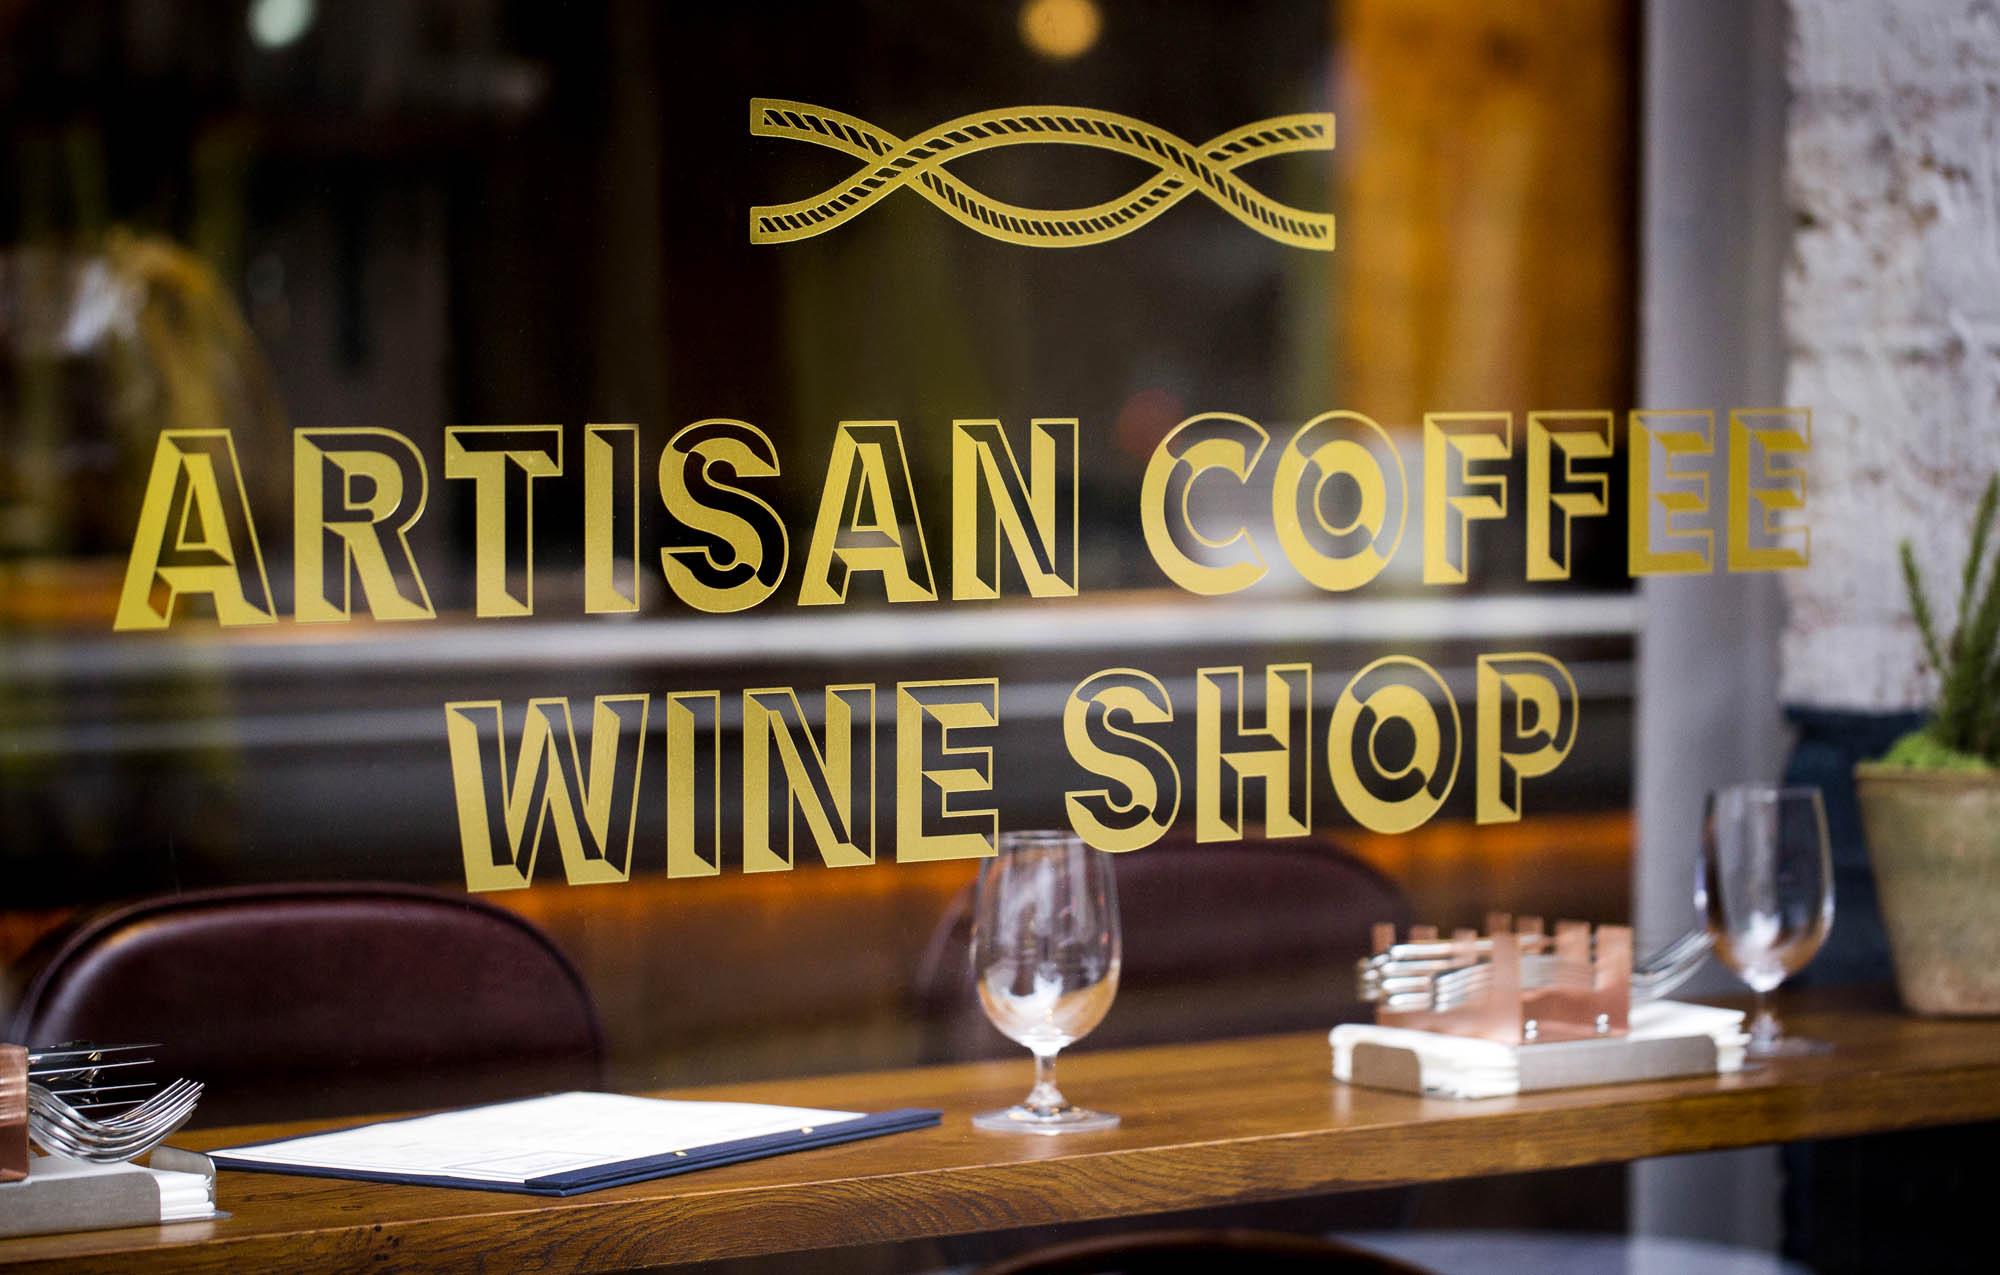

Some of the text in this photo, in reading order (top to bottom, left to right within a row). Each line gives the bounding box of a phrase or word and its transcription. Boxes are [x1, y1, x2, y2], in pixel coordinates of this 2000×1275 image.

[113, 408, 1812, 632] ARTISAN COFFEE
[445, 652, 1580, 893] WINE SHOP
